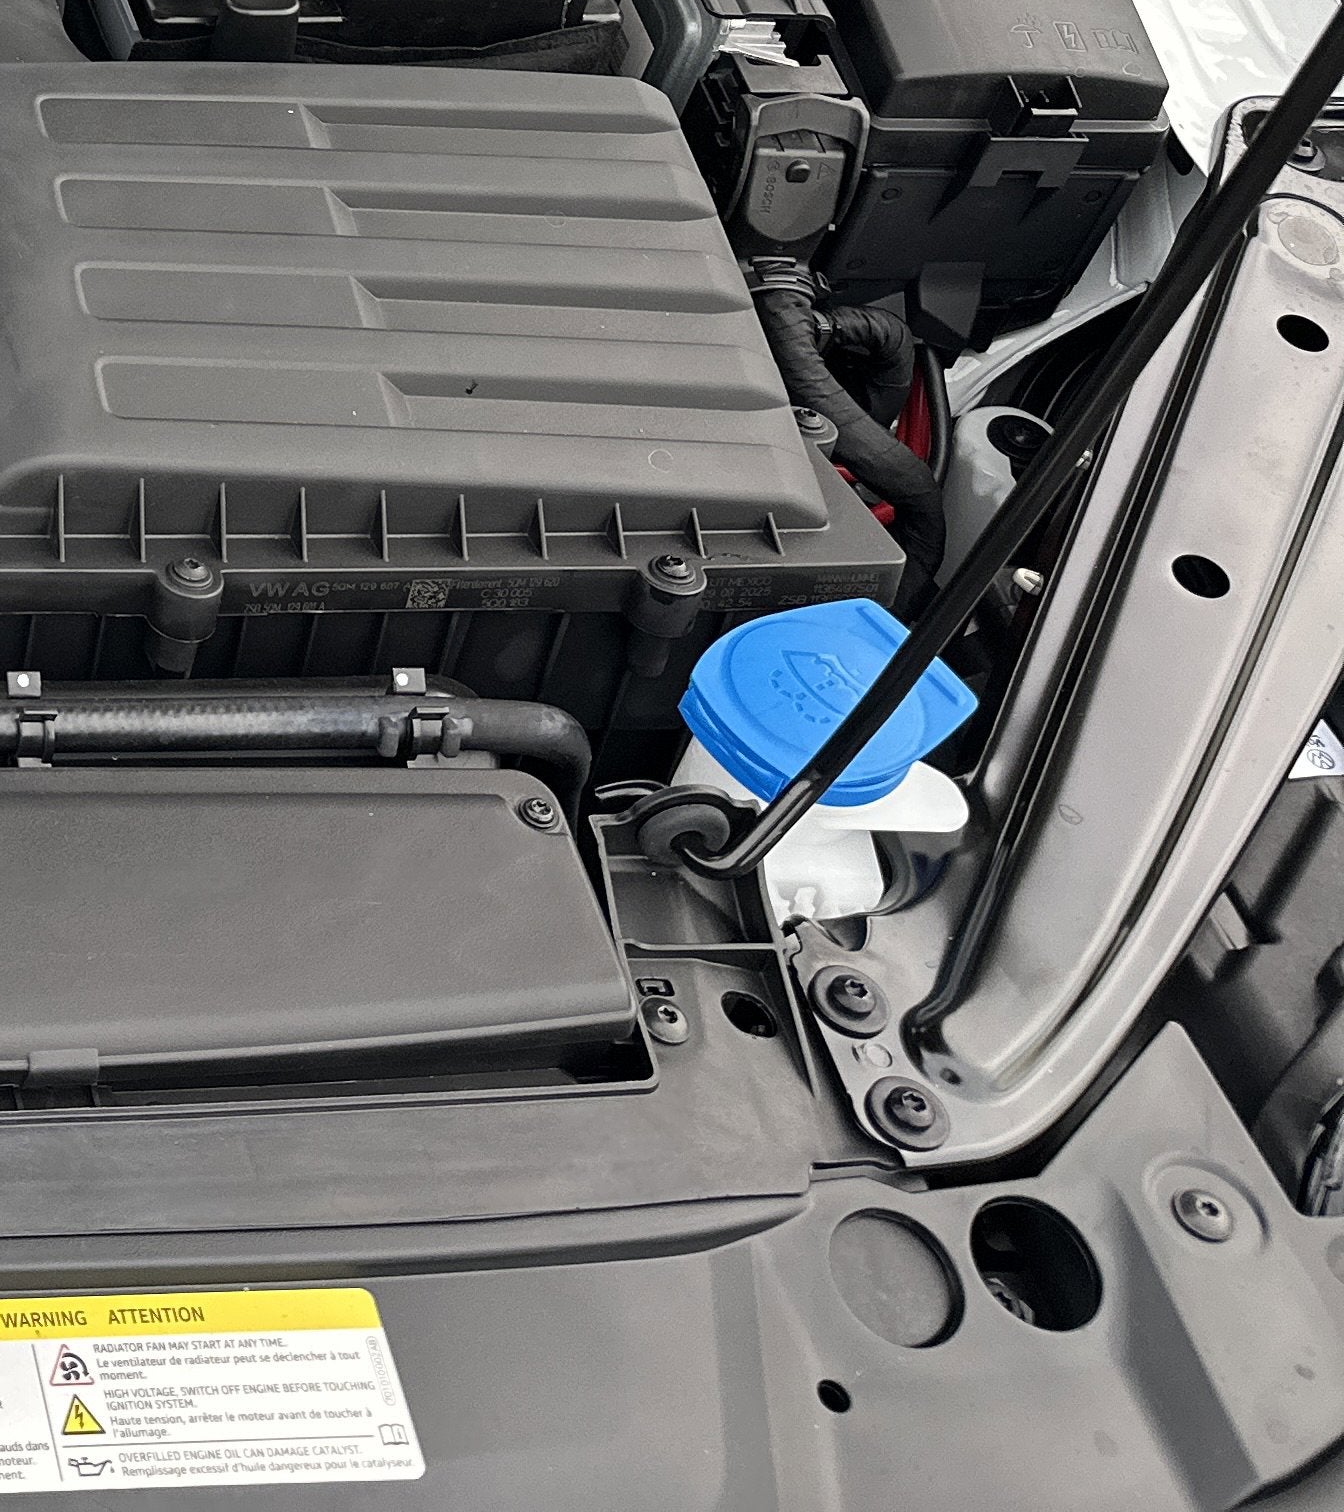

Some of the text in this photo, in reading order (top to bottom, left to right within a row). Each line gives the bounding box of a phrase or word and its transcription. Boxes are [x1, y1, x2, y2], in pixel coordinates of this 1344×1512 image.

[760, 175, 776, 214] BOSCH
[249, 581, 290, 597] VW
[291, 580, 330, 597] AG
[0, 1306, 206, 1328] WARNING ATTENTION
[93, 1342, 144, 1354] RADIATOR
[146, 1341, 166, 1352] FAN
[168, 1340, 190, 1351] MAY
[191, 1339, 221, 1350] START
[223, 1339, 235, 1349] AT
[237, 1338, 258, 1349] ANY
[96, 1358, 109, 1368] Le
[111, 1356, 166, 1367] ventilateur
[168, 1355, 182, 1365] de
[184, 1354, 230, 1365] radiateur
[234, 1354, 257, 1366] peut
[259, 1354, 271, 1363] se
[338, 1350, 361, 1361] tout
[103, 1388, 130, 1399] HIGH
[180, 1385, 220, 1396] SWITCH
[222, 1384, 241, 1395] OFF
[243, 1383, 280, 1394] ENGINE
[282, 1382, 322, 1393] BEFORE
[324, 1380, 376, 1392] TOUCHING
[106, 1400, 153, 1411] IGNITION
[26, 1440, 50, 1452] dans
[118, 1452, 181, 1464] OVERFILLED
[183, 1450, 222, 1461] ENGINE
[224, 1448, 241, 1459] OIL
[242, 1447, 265, 1459] CAN
[266, 1446, 310, 1458] DAMAGE
